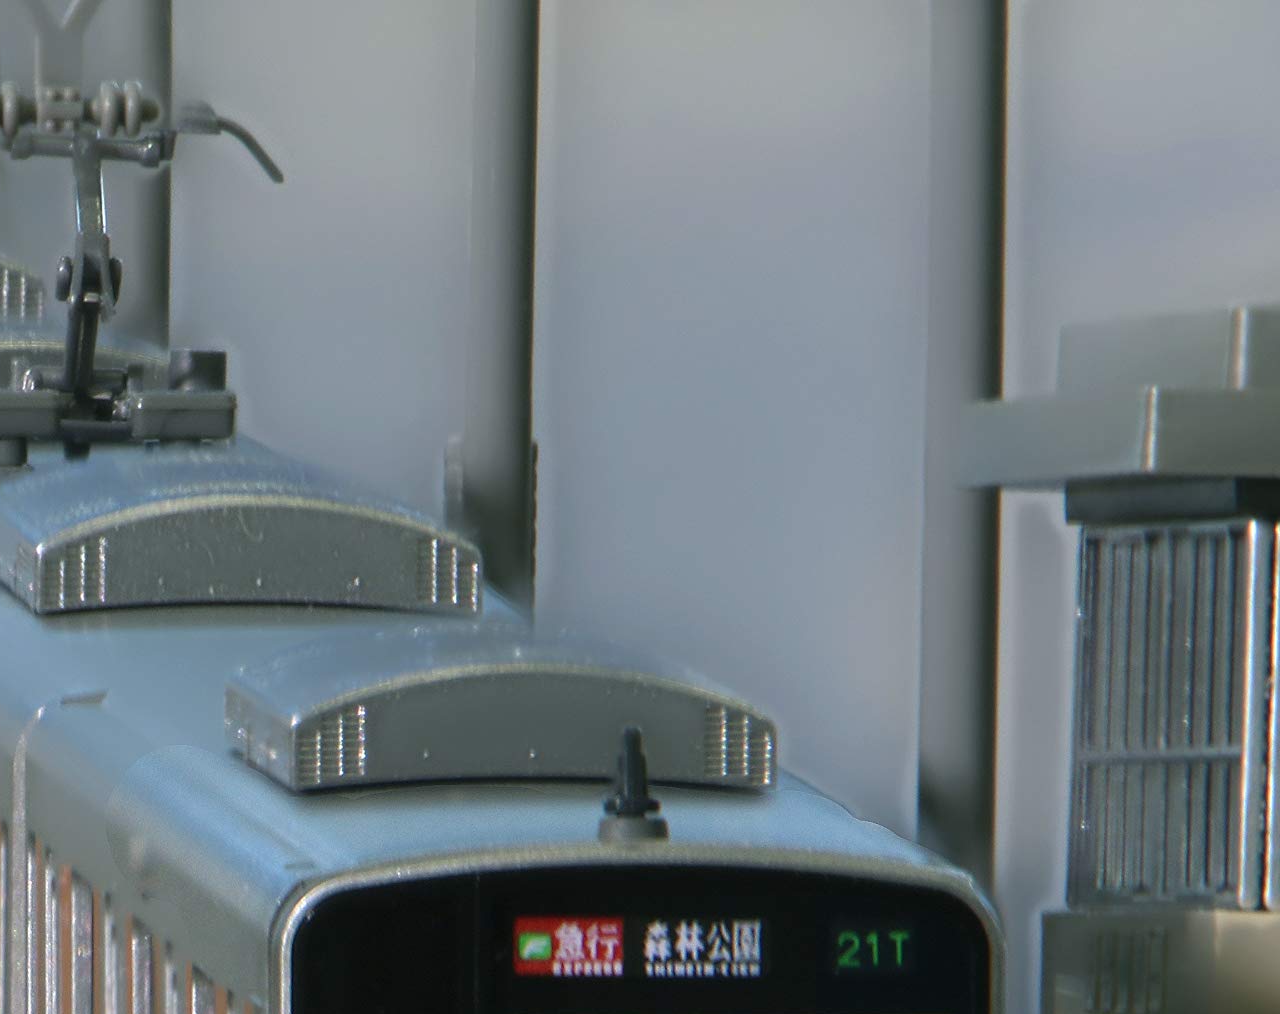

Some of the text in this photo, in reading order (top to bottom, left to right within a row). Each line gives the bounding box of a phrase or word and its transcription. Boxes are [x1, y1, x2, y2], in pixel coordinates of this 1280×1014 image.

[554, 921, 621, 960] 急行
[643, 920, 761, 961] 森林公園
[838, 930, 910, 968] 21T
